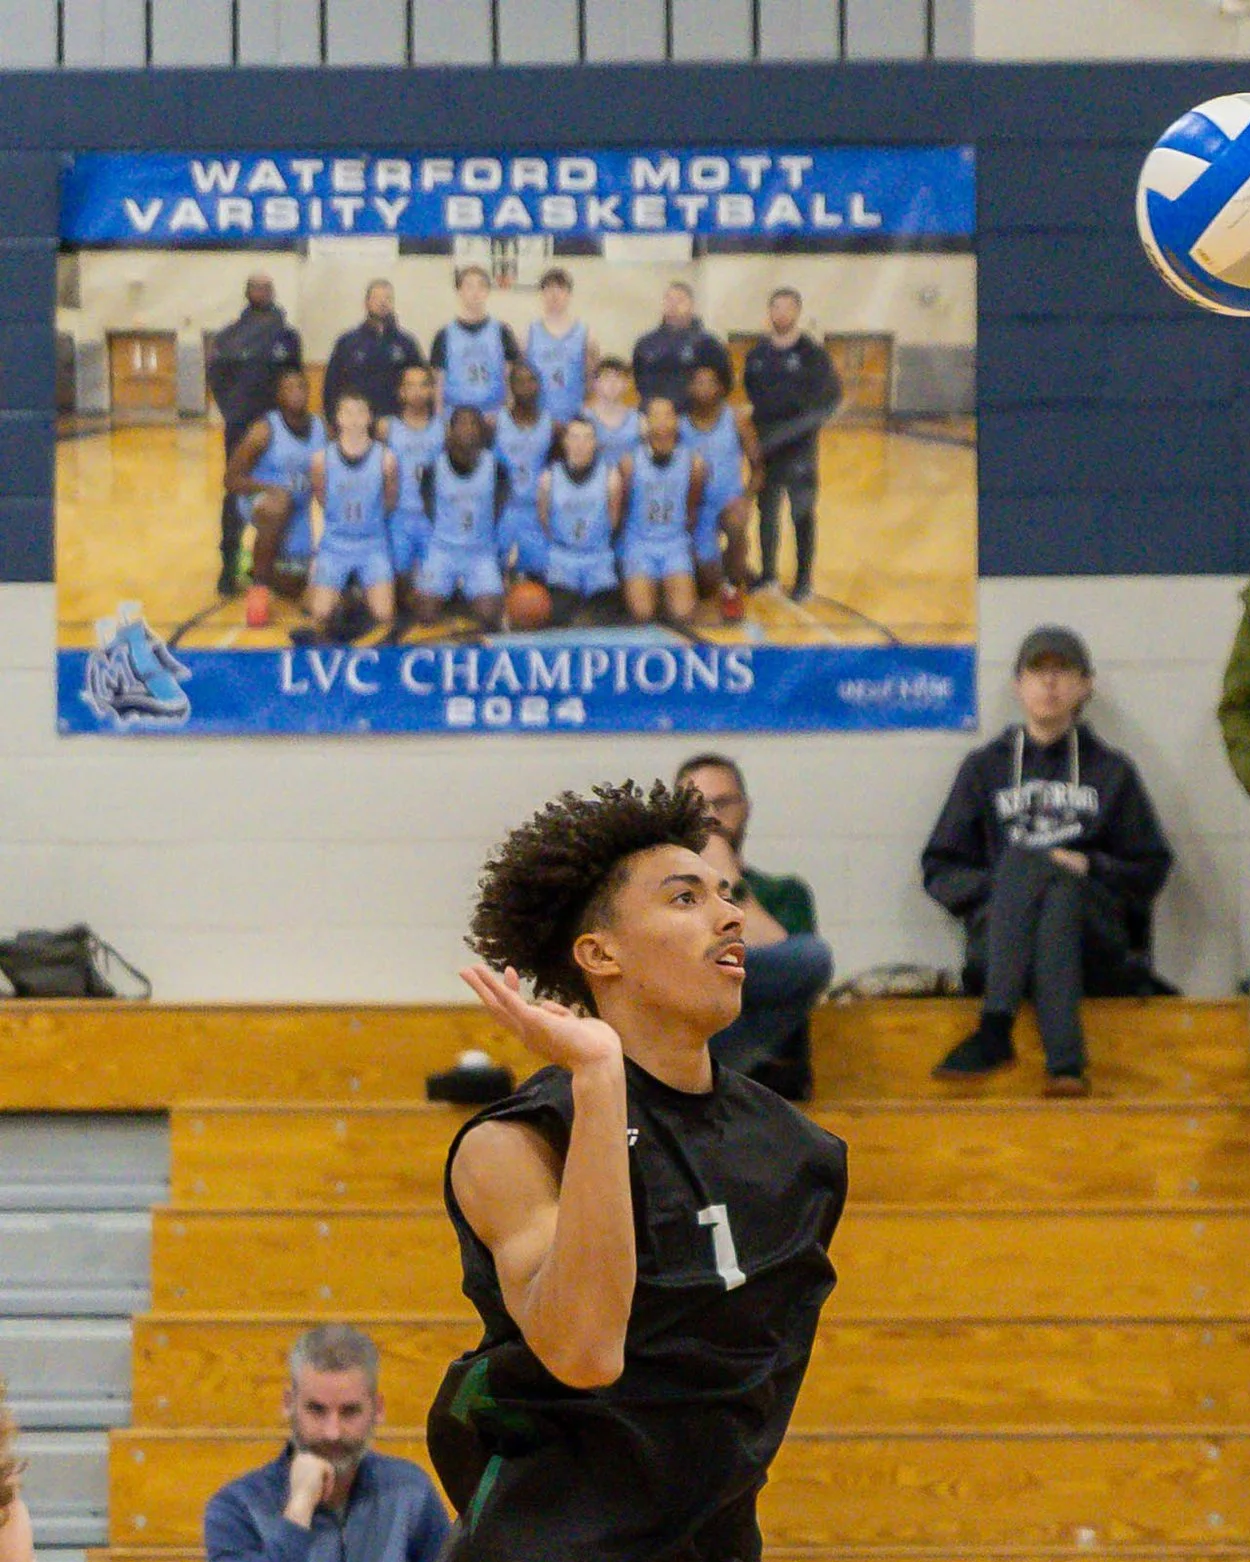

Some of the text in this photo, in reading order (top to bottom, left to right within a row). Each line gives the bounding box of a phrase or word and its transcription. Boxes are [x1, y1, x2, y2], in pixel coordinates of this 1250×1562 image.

[191, 154, 813, 193] WATERFORD MOTT
[123, 191, 882, 231] VARSITY BASKETBALL
[279, 647, 755, 695] LVC CHAMPIONS
[445, 696, 586, 727] 2024
[698, 1204, 746, 1291] 1
